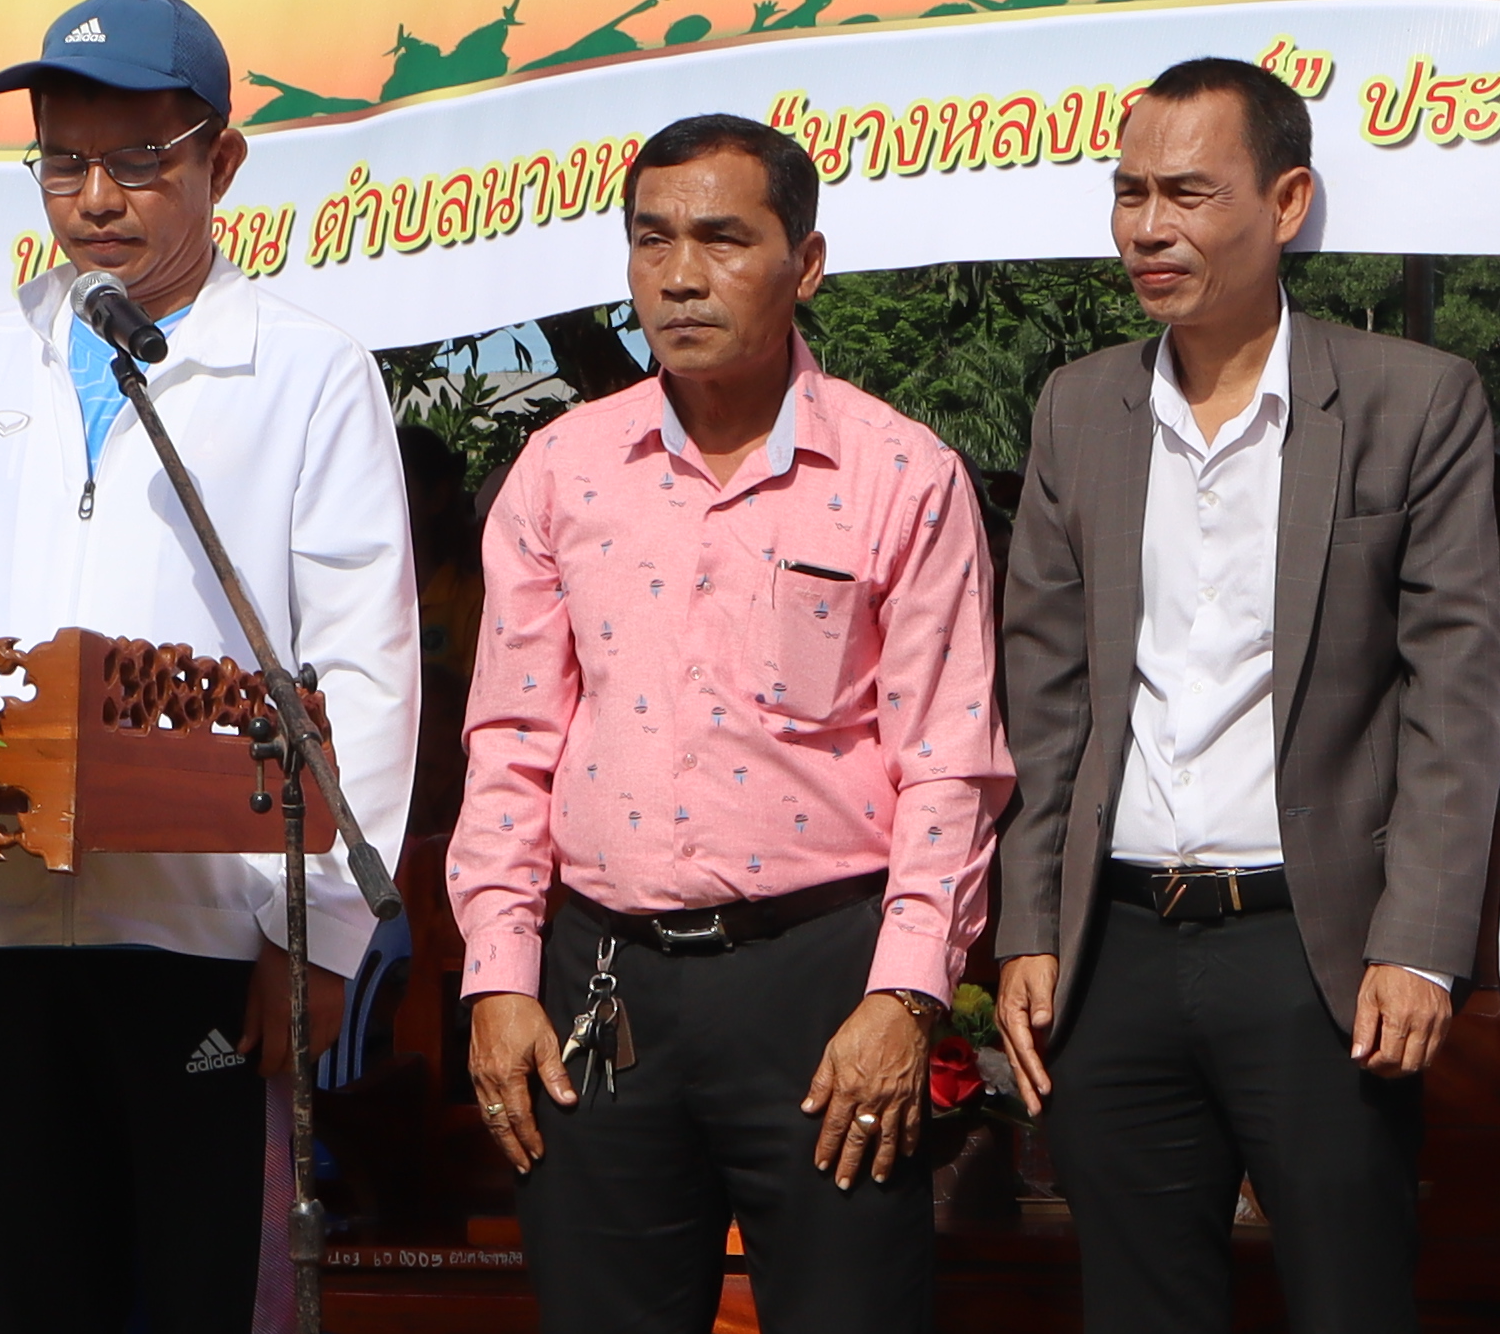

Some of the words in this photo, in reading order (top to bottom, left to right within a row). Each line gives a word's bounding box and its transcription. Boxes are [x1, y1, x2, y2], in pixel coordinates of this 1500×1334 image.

[309, 138, 639, 259] ตำบลนางห
[186, 1054, 246, 1073] adidas
